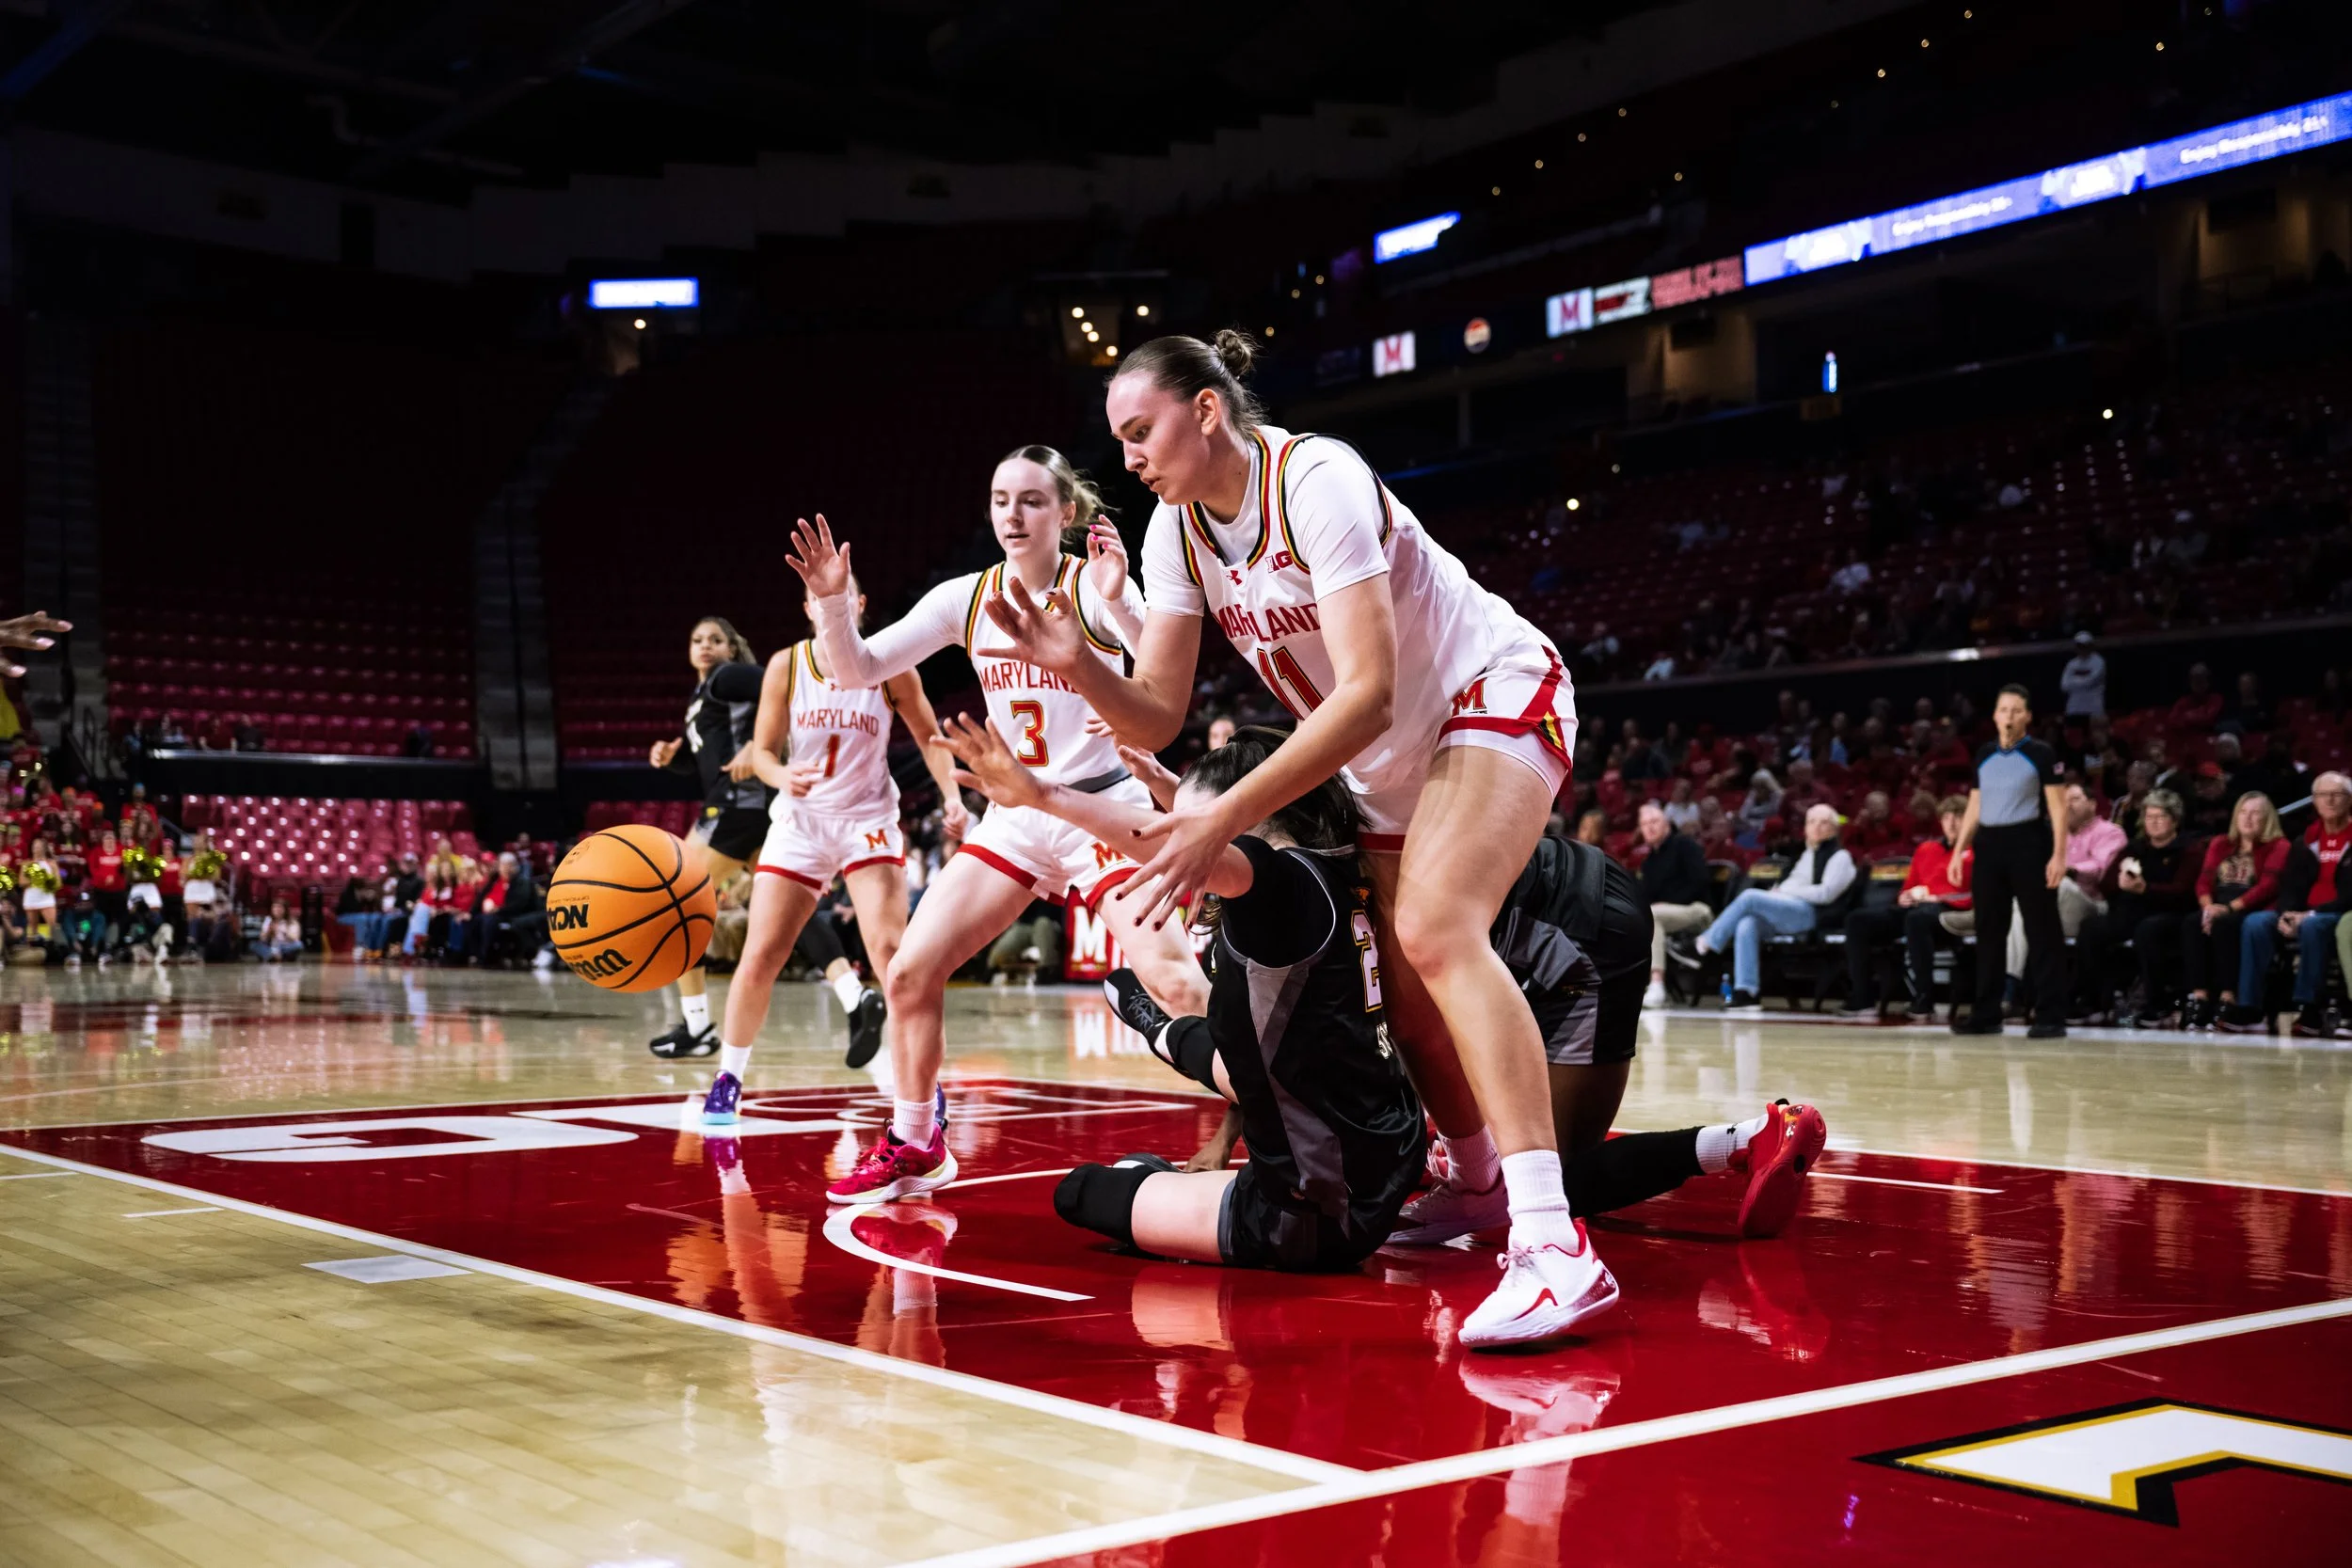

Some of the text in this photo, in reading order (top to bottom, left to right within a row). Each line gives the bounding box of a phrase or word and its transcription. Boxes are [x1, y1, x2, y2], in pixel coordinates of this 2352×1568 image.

[1213, 603, 1321, 642] MARLAND
[979, 661, 1081, 694] MARYLAN
[1257, 645, 1325, 721] 11
[1451, 677, 1487, 718] M
[797, 708, 880, 737] MARYLAND
[1010, 700, 1050, 768] 3
[823, 733, 841, 778] 1
[864, 828, 891, 851] M
[547, 904, 589, 931] NCA
[1071, 905, 1108, 962] M
